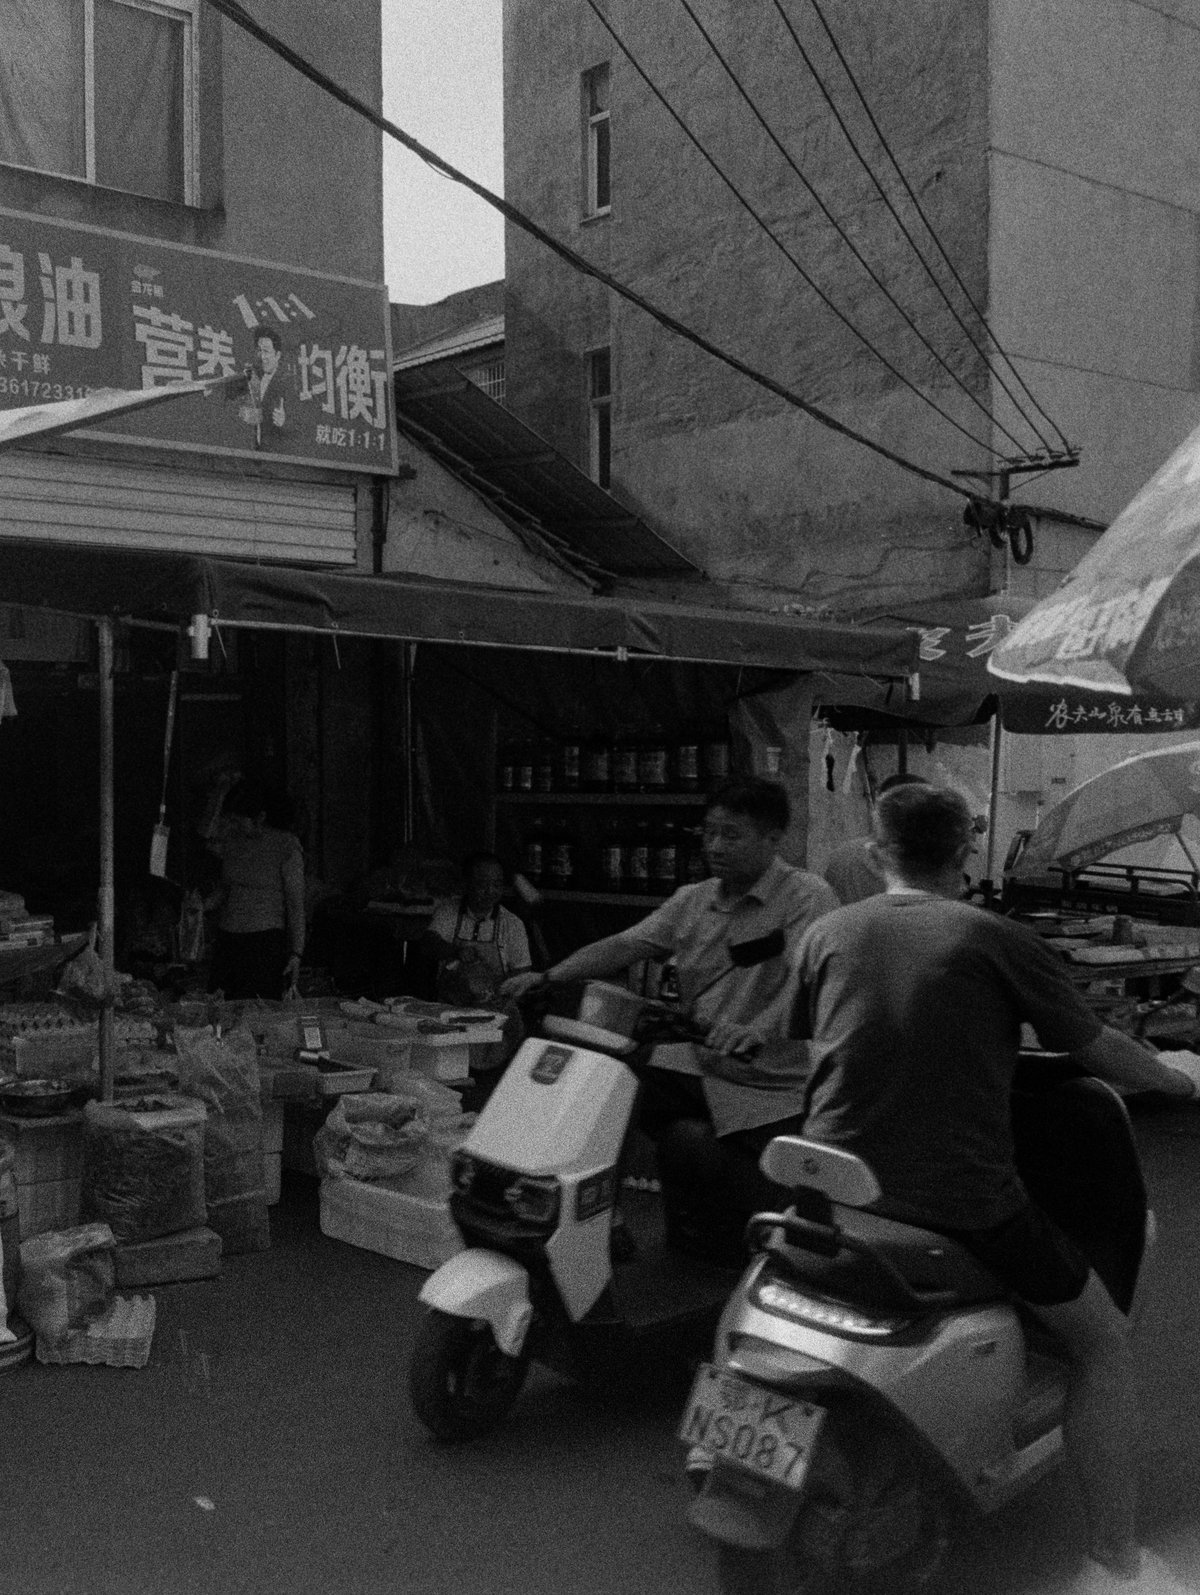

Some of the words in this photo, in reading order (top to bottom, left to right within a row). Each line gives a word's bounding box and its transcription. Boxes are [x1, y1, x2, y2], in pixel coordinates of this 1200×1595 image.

[132, 305, 236, 398] 营养
[298, 344, 387, 430] 均衡
[315, 424, 385, 451] 就吃1:1:1
[1045, 698, 1185, 729] 农夫山泉有点甜
[686, 1404, 803, 1478] NS087
